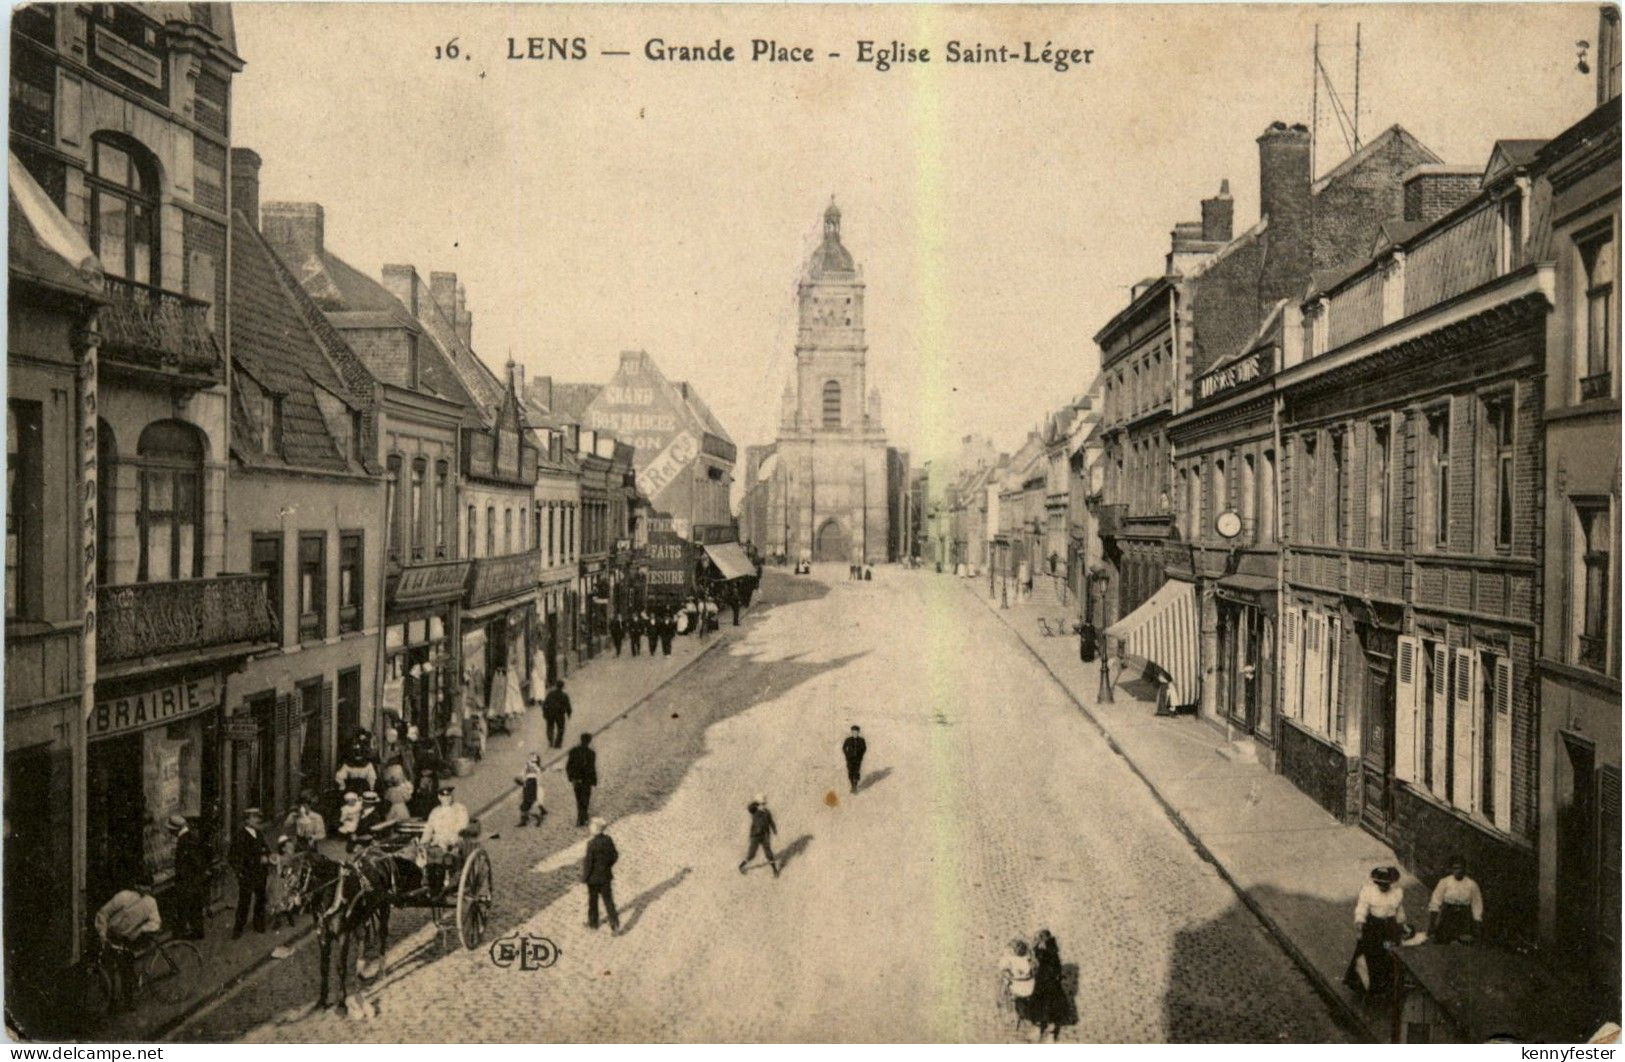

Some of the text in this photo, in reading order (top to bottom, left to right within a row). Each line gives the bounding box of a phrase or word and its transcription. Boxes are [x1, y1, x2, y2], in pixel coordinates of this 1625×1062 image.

[436, 38, 470, 60] 16.
[508, 38, 586, 60] LENS
[645, 39, 734, 61] Grande
[752, 40, 813, 62] Place
[857, 41, 930, 71] Eglise
[947, 41, 1094, 72] Saint-Léger
[650, 544, 682, 559] FAITS
